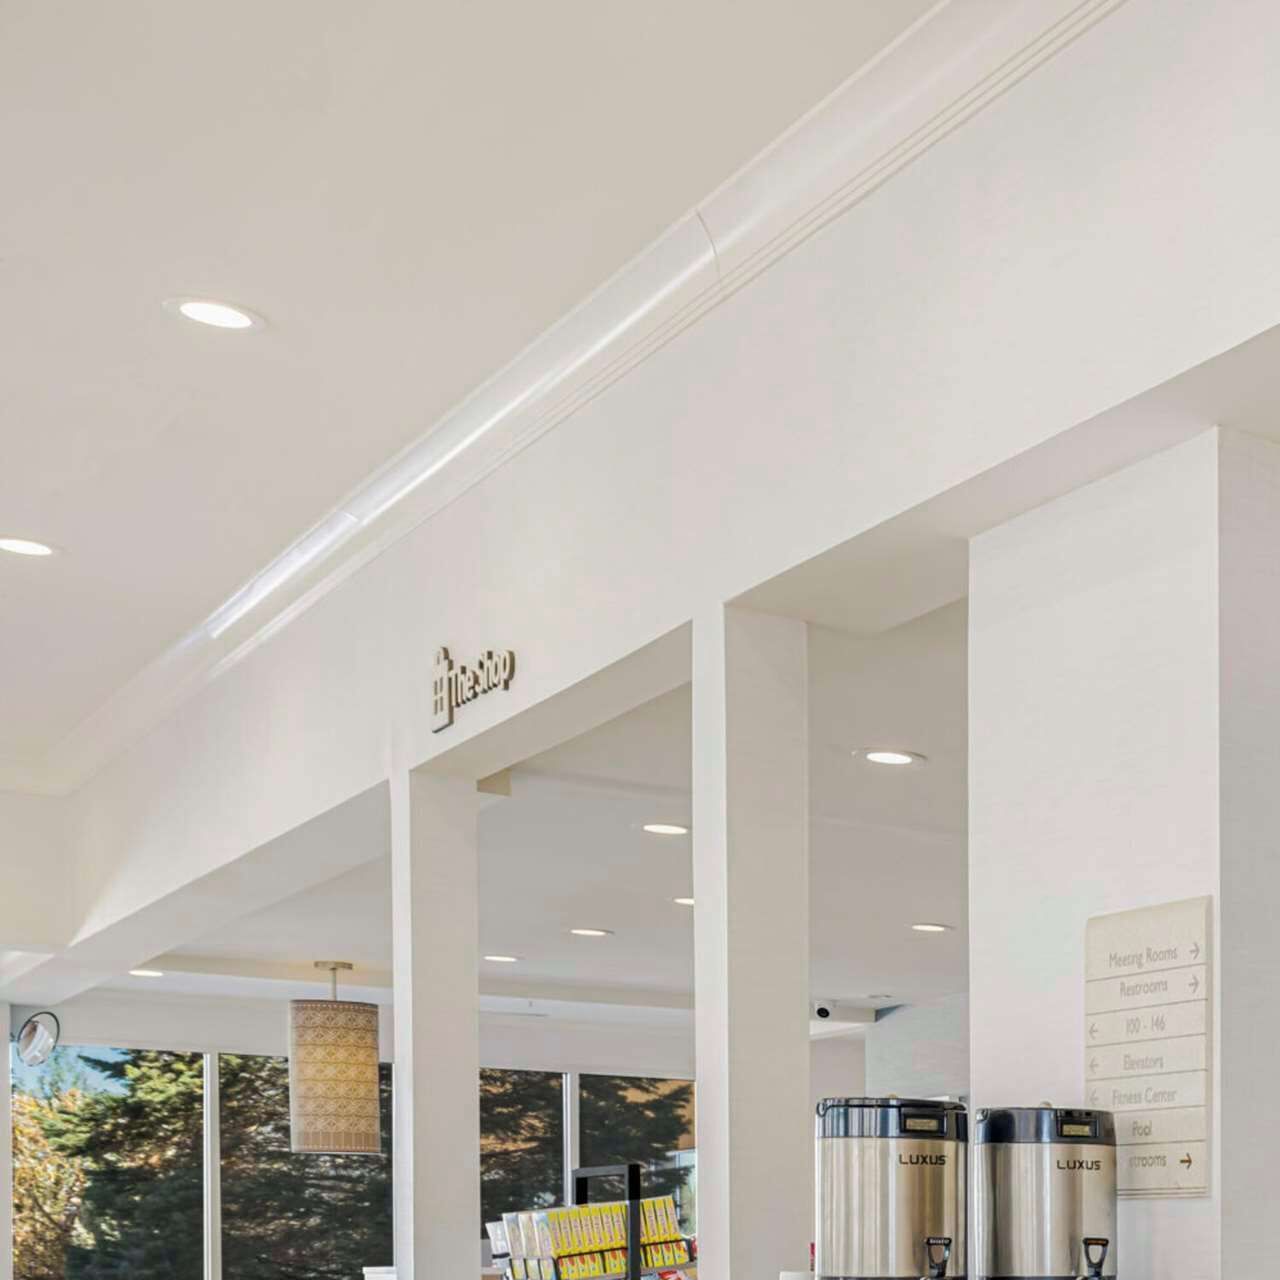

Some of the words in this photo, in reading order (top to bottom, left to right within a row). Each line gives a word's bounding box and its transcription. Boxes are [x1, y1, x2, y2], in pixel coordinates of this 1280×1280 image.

[1108, 951, 1144, 969] Meeting
[1146, 946, 1178, 962] Rooms
[1120, 980, 1168, 998] Restrooms
[1123, 1053, 1164, 1071] Elevators
[1112, 1088, 1142, 1106] Fitness
[1145, 1086, 1177, 1104] Center
[1132, 1120, 1153, 1137] Pool
[899, 1154, 948, 1166] LUXUS
[1057, 1159, 1101, 1171] LUXUS
